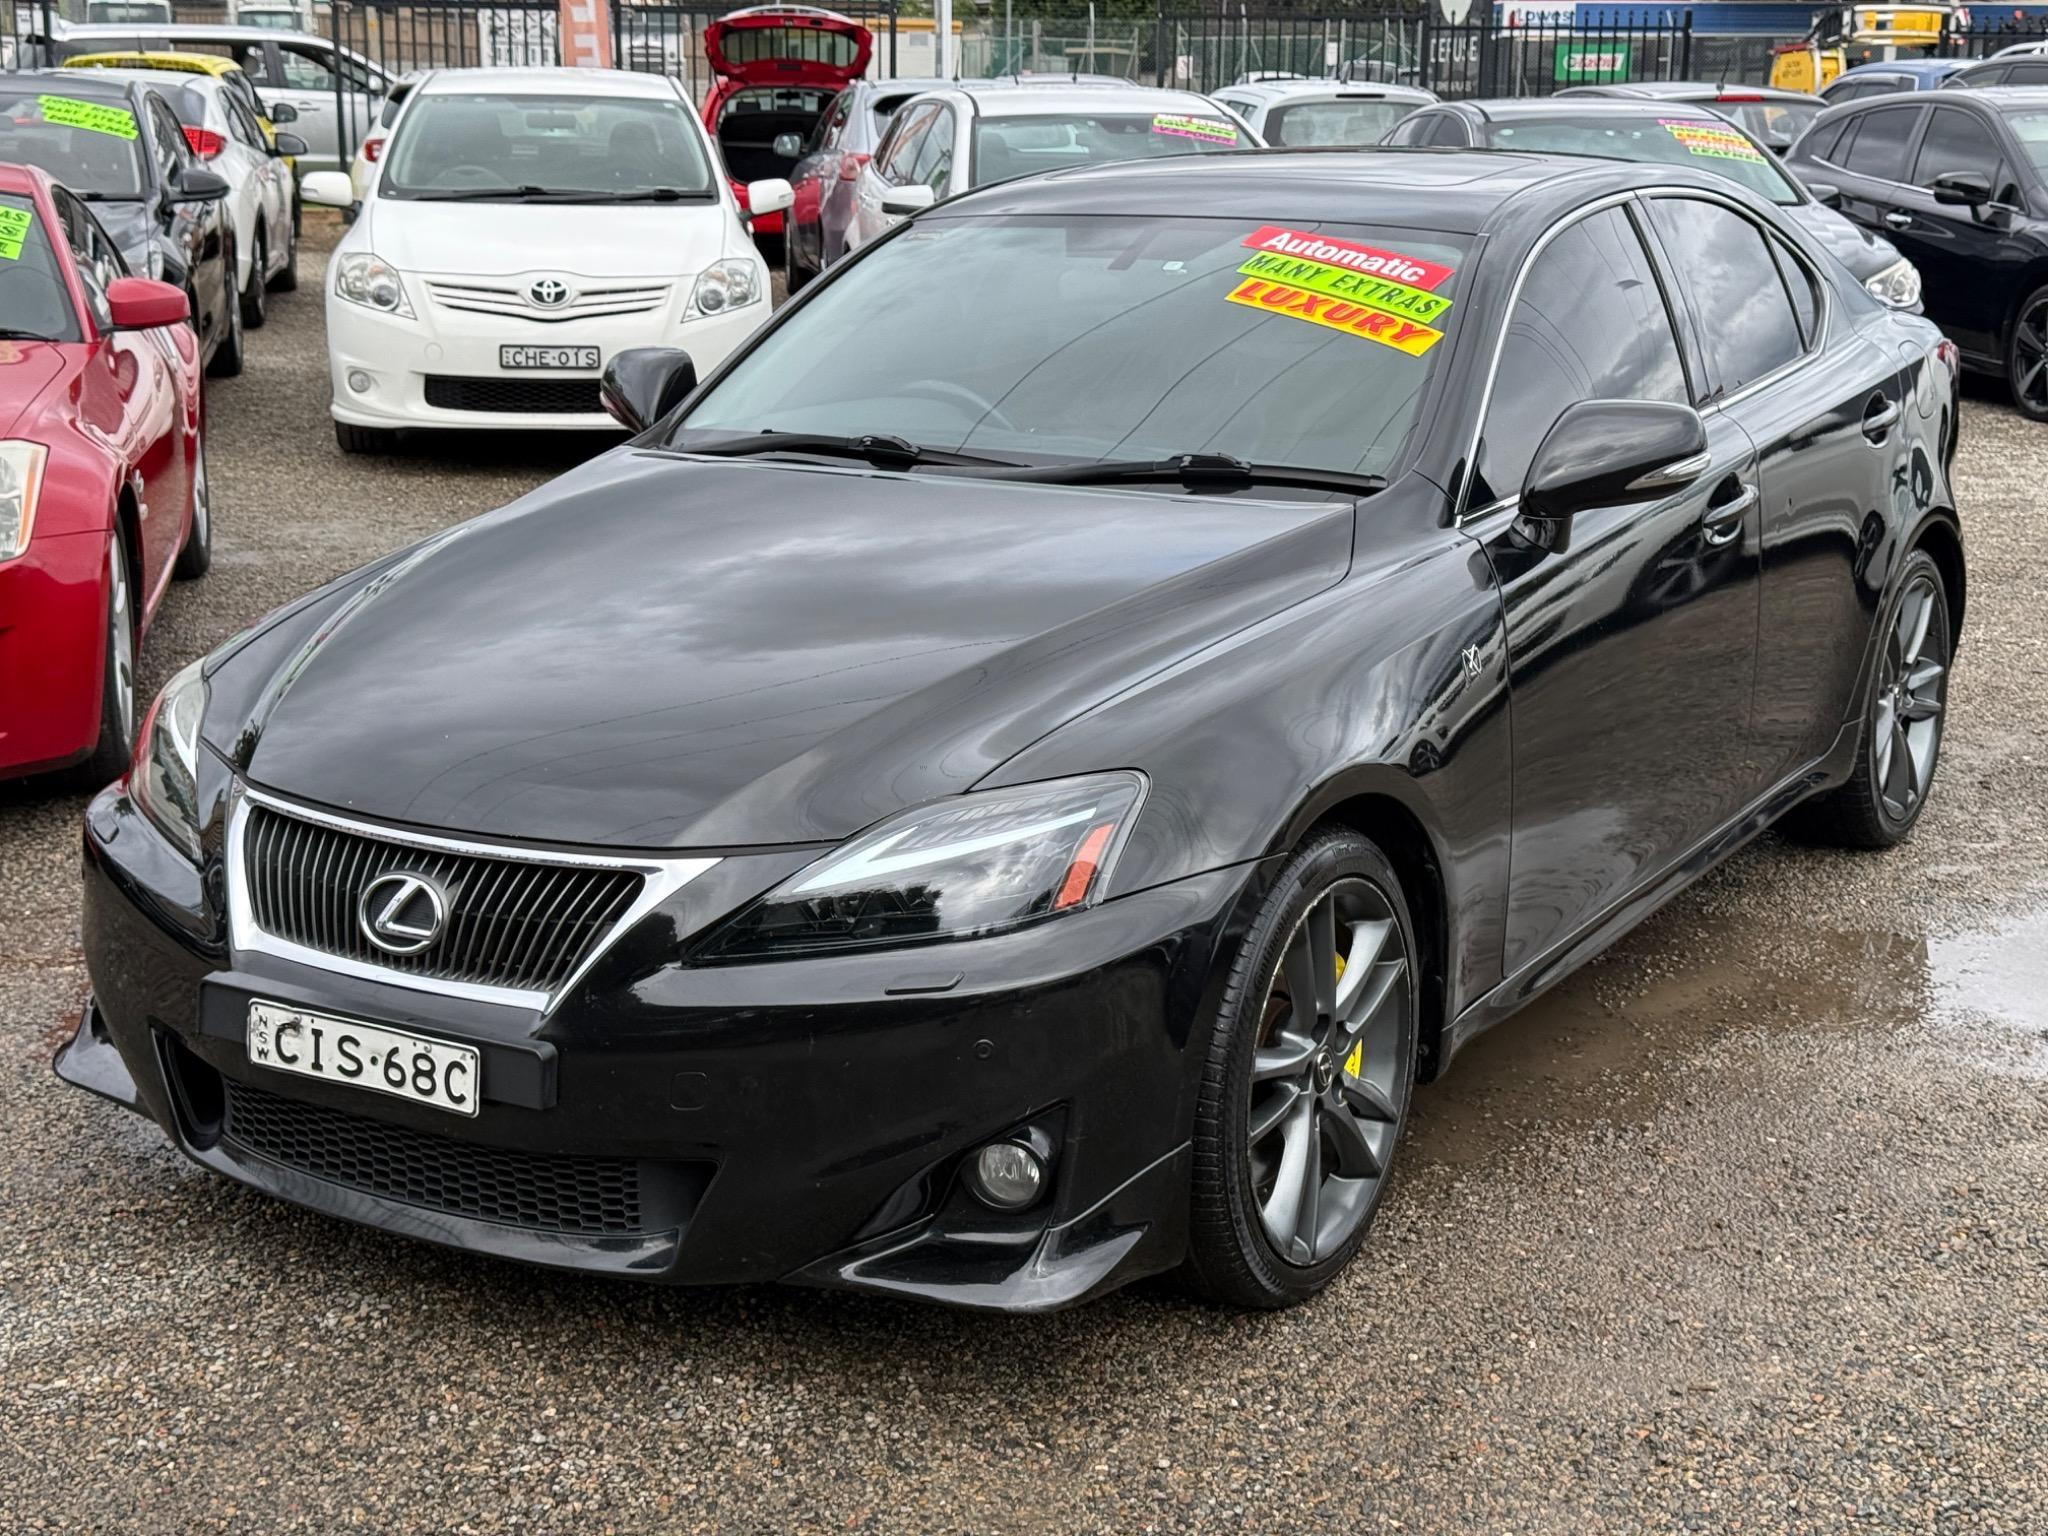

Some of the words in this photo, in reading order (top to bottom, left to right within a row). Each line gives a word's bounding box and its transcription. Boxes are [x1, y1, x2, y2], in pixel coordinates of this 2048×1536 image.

[1245, 255, 1329, 281] MANY
[1330, 274, 1442, 315] EXTRAS
[1262, 232, 1426, 283] Automatic
[1235, 281, 1433, 343] LUXURY
